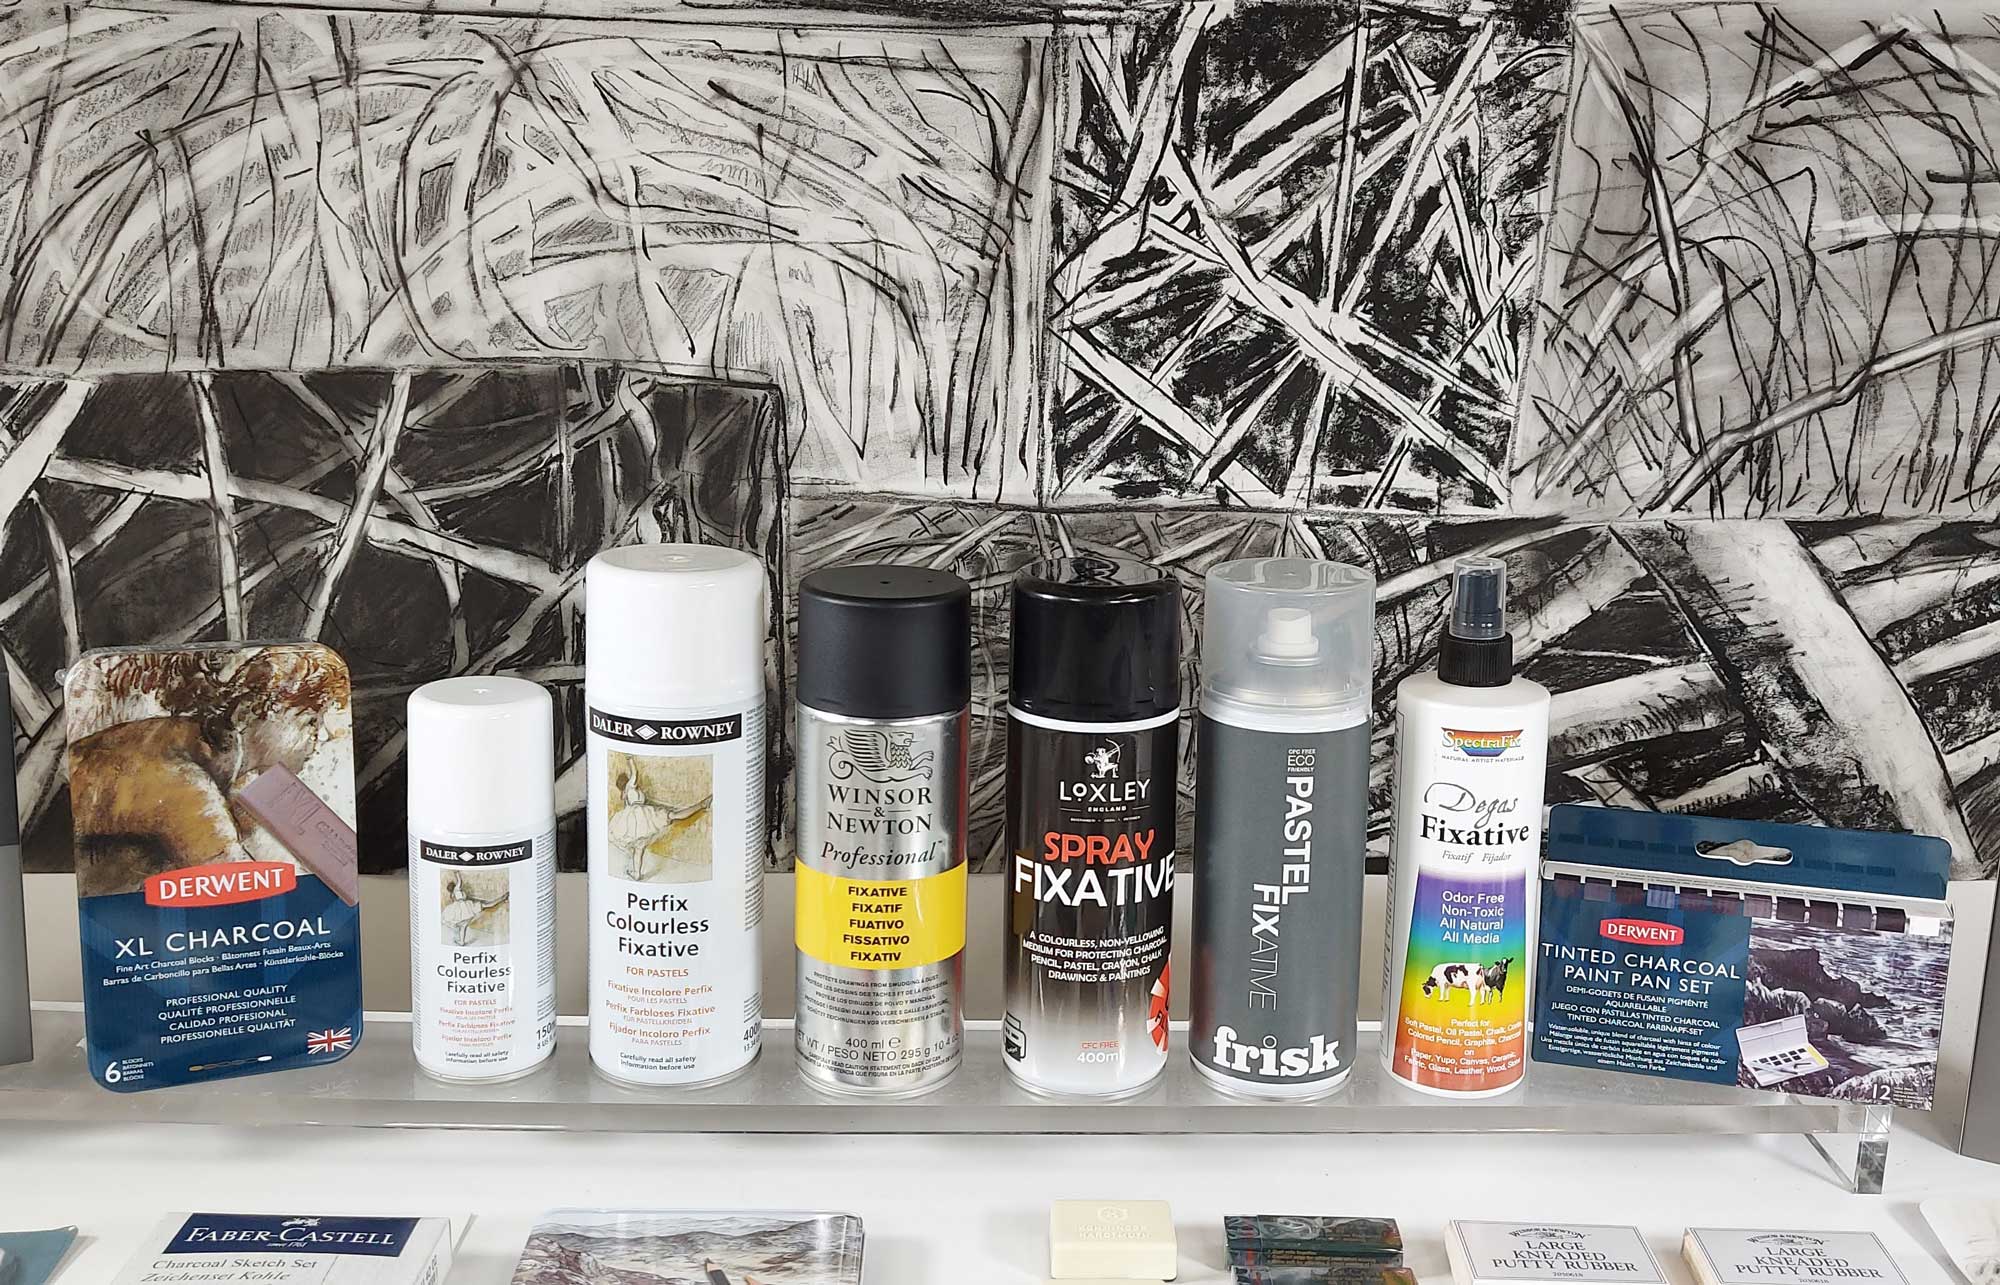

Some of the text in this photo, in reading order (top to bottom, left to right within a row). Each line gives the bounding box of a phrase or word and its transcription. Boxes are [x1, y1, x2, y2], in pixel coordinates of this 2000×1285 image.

[593, 714, 735, 740] DALER ROWNEY
[1442, 730, 1521, 752] SpectraFix
[1288, 755, 1315, 766] ECO
[828, 784, 933, 806] WINSOR
[1059, 778, 1151, 802] LOXLEY
[873, 806, 886, 818] &
[1087, 805, 1127, 813] ENGLAND
[1424, 782, 1519, 829] Degas
[826, 811, 933, 836] NEWTON
[1420, 814, 1529, 846] Fixative
[1044, 829, 1155, 865] SPRAY
[1281, 776, 1314, 905] PASTEL
[425, 846, 525, 861] DALER ROWNEY
[1442, 850, 1512, 864] Fixatif Fijador
[159, 868, 284, 900] DERWENT
[1015, 850, 1175, 907] FIXATIVE
[848, 886, 908, 897] FIXATIVE
[1442, 890, 1505, 904] Odor Free
[627, 892, 689, 912] Perfix
[851, 903, 903, 914] FIXATIF
[1441, 904, 1505, 917] Non-Toxic
[606, 911, 709, 934] Colourless
[849, 919, 904, 930] FIJATIVO
[1440, 918, 1504, 931] All Natural
[114, 917, 331, 958] XL CHARCOAL
[843, 935, 910, 945] FISSATIVO
[1029, 925, 1164, 949] A COLOURLESS, NON-YELLOWING
[1442, 931, 1500, 945] All Media
[1607, 923, 1678, 942] DERWENT
[619, 936, 699, 957] Fixative
[1022, 938, 1133, 960] MEDIUM FOR PROTECTING
[1249, 883, 1281, 1011] FIXATIVE
[116, 965, 133, 973] Fine
[151, 958, 187, 969] Charcoal
[189, 955, 215, 964] Blocks
[262, 946, 286, 956] Fusain
[288, 941, 331, 952] Beaux-Arts
[453, 952, 497, 964] Perfix
[850, 952, 902, 962] FIXATIV
[1031, 949, 1162, 972] PENCIL, PASTEL, CRAYON, CHALK
[1541, 942, 1741, 979] TINTED CHARCOAL
[103, 976, 129, 986] Barras
[131, 975, 142, 983] de
[144, 969, 190, 981] Carboncillo
[192, 968, 210, 977] para
[212, 963, 234, 973] Bellas
[235, 962, 257, 970] Artes
[437, 965, 511, 979] Colourless
[626, 966, 689, 978] FOR PASTELS
[1048, 965, 1151, 982] DRAWINGS & PAINTINGS
[1564, 965, 1714, 995] PAINT PAN SET
[166, 984, 288, 1007] PROFESSIONAL QUALITY
[447, 981, 505, 993] Fixative
[608, 980, 713, 997] Fixative Incolore Perfix
[1566, 985, 1622, 998] DEMI-GODETS
[1636, 994, 1666, 1004] FUSAIN
[206, 995, 296, 1014] PROFESSIONNELLE
[606, 1000, 716, 1018] Perfix Farbloses Fixative
[1605, 1000, 1667, 1013] AQUARELLABLE
[169, 1009, 287, 1031] CALIDAD PROFESIONAL
[1451, 1018, 1479, 1027] Perfect
[1551, 1002, 1720, 1029] JUEGO CON PASTILLAS TINTED CHARCOAL
[1567, 1013, 1597, 1023] TINTED
[1598, 1017, 1645, 1029] CHARCOAL
[160, 1018, 296, 1044] PROFESSIONELLE QUALITÄT
[609, 1022, 711, 1038] Fijador Incoloro Perfix
[1407, 1028, 1435, 1041] Colored
[1445, 1027, 1457, 1036] Oil
[845, 1038, 884, 1049] 400 ml
[1100, 1041, 1119, 1049] FREE
[1213, 1025, 1340, 1077] frisk
[620, 1052, 647, 1063] Carefully
[675, 1055, 696, 1064] safety
[827, 1045, 859, 1061] PESO
[862, 1051, 897, 1062] NETO
[901, 1047, 922, 1060] 295
[105, 1061, 121, 1083] 6
[620, 1059, 658, 1070] information
[659, 1063, 682, 1071] before
[1872, 1083, 1891, 1101] 12
[184, 1227, 395, 1245] FABER-CASTELL
[1525, 1240, 1586, 1251] LARGE
[1765, 1247, 1827, 1257] LARGE
[152, 1259, 318, 1269] Charcoal Sketch Set
[1513, 1250, 1606, 1261] KNEADED
[1754, 1256, 1849, 1267] KNEADED
[1492, 1258, 1639, 1272] PUTTY RUBBER
[1734, 1265, 1884, 1278] PUTTY RUBBER
[141, 1271, 291, 1282] Zeichenset Kohle
